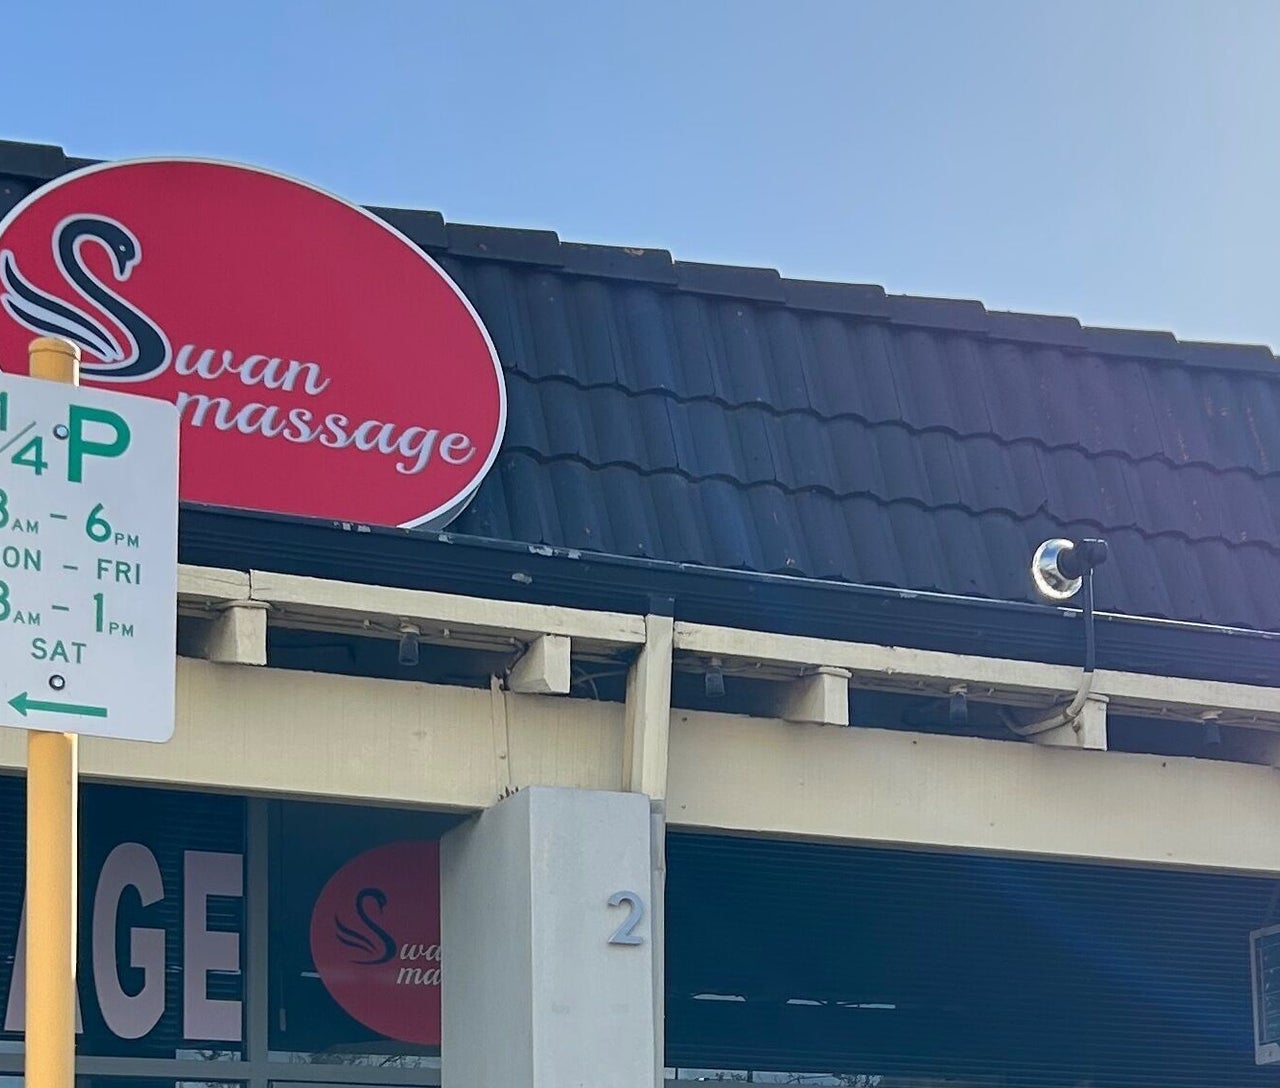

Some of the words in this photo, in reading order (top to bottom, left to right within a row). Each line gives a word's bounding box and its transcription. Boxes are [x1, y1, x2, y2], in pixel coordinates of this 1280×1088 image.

[67, 404, 131, 483] P
[174, 389, 477, 475] massage
[97, 557, 142, 586] FRI
[31, 637, 87, 664] SAT
[607, 890, 644, 946] 2
